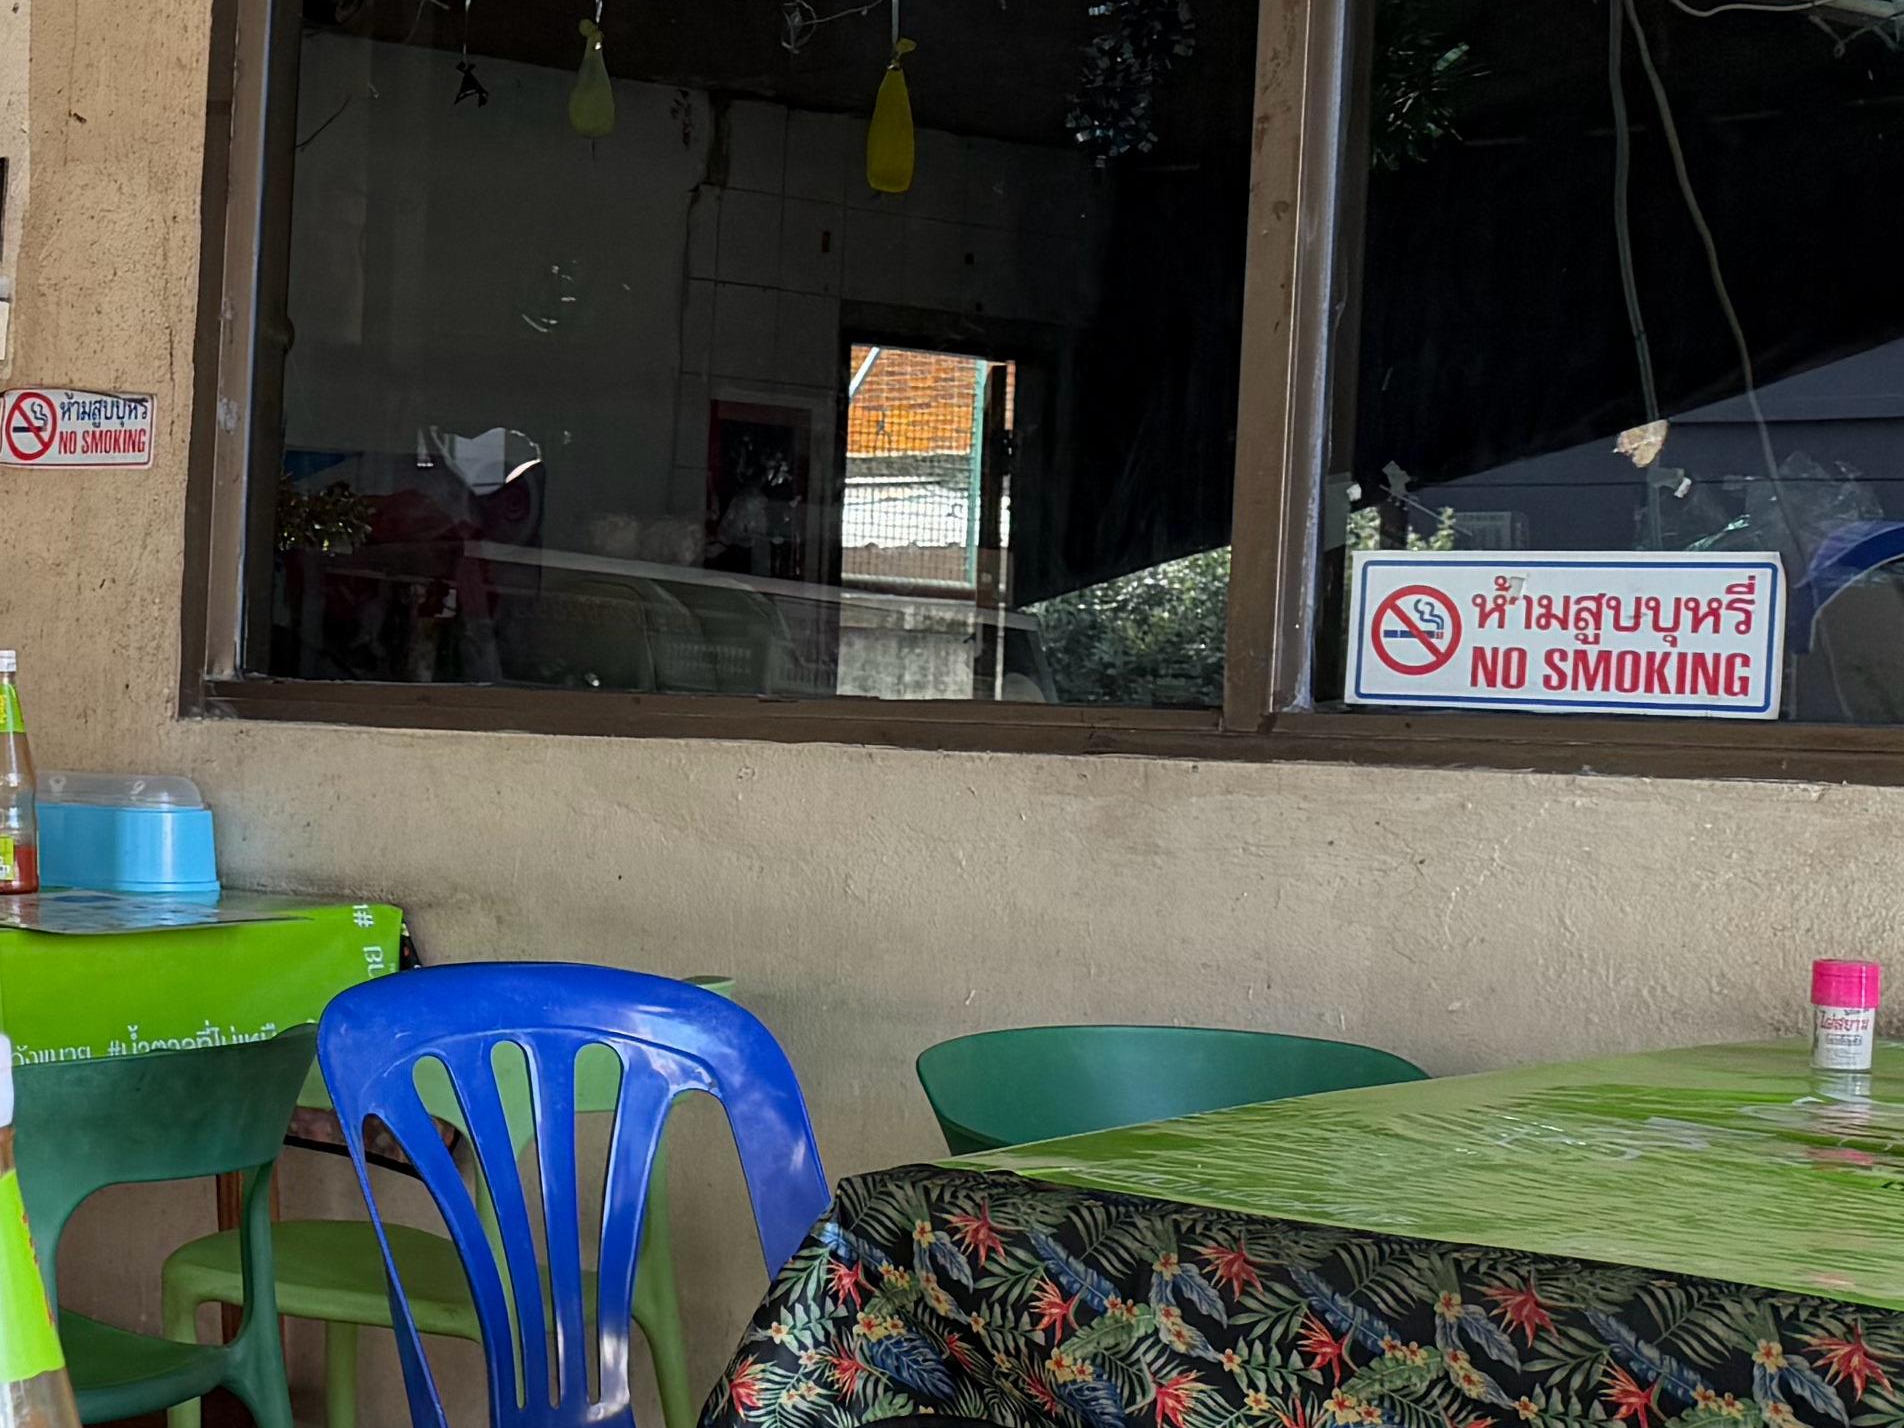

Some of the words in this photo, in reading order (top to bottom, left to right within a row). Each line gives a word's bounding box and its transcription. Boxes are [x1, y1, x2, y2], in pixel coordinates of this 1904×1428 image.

[59, 430, 77, 455] NO
[82, 428, 146, 454] SMOKING
[1471, 575, 1757, 649] ห้ามสูบบุหรี่
[1470, 646, 1527, 690] NO
[1542, 647, 1751, 697] SMOKING
